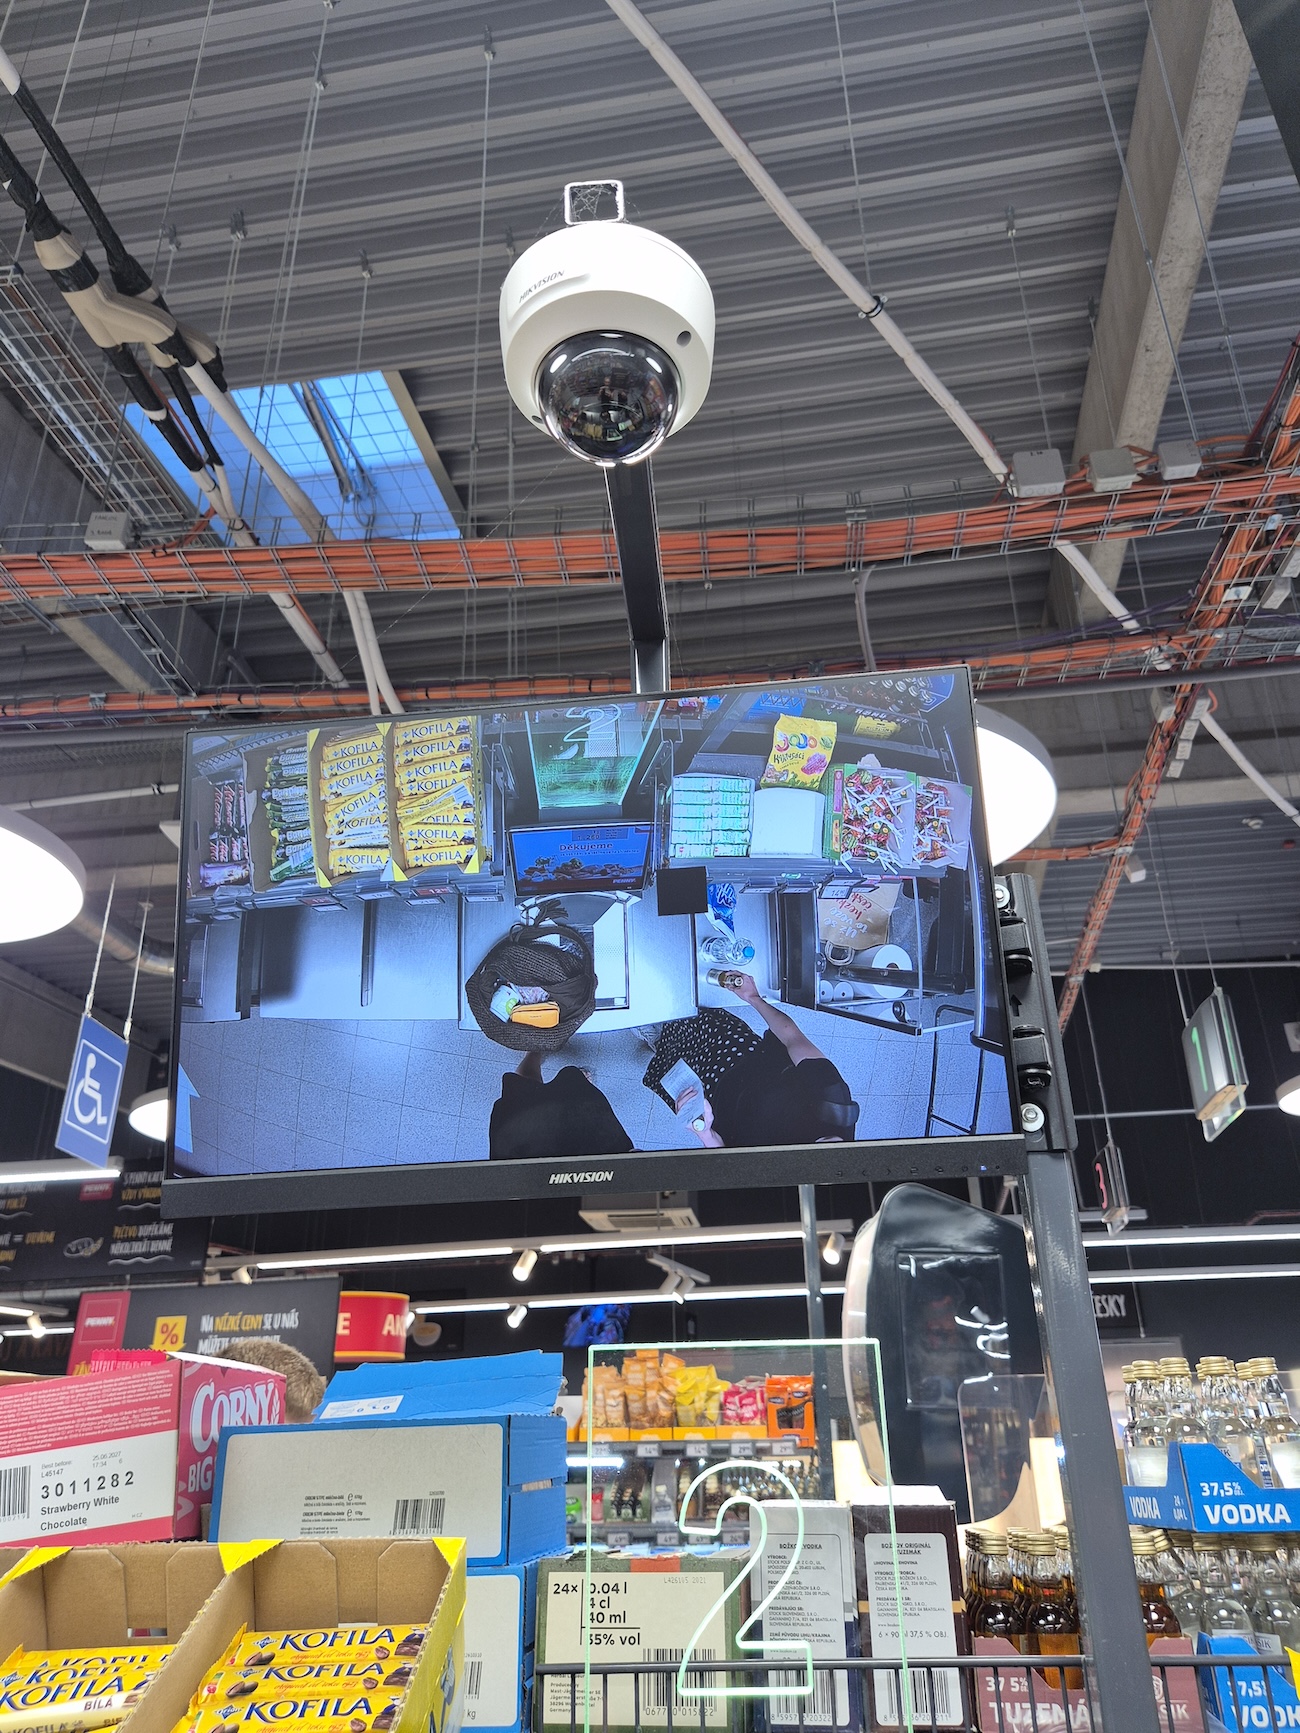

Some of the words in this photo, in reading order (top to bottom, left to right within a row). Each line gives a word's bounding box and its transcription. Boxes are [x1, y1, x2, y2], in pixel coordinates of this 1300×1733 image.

[519, 270, 565, 303] HIKVISION
[411, 721, 454, 738] KOFILA
[340, 741, 378, 757] KOFILA
[413, 740, 456, 757] KOFILA
[336, 756, 374, 772] KOFILA
[415, 760, 458, 777] KOFILA
[335, 771, 373, 790] KOFILA
[340, 791, 377, 817] KOFILA
[417, 829, 459, 840] KOFILA
[559, 842, 614, 853] Děkujeme
[345, 854, 383, 866] KOFILA
[422, 850, 462, 864] KOFILA
[548, 1171, 614, 1184] HIKVISION
[1093, 1294, 1126, 1318] ESKY
[92, 1451, 122, 1461] 25.06.2027
[41, 1469, 64, 1478] L45147
[92, 1461, 107, 1469] 17:34
[41, 1501, 91, 1516] Strawberry
[93, 1495, 120, 1507] White
[1129, 1495, 1161, 1520] VODKA
[1203, 1503, 1291, 1526] VODKA
[40, 1516, 88, 1531] Chocolate
[677, 1458, 814, 1696] 2
[599, 1596, 611, 1609] cl
[609, 1611, 626, 1624] ml
[279, 1627, 396, 1652] KOFILA
[619, 1632, 640, 1646] vol
[263, 1662, 385, 1682] KOFILA
[0, 1676, 124, 1712] KOFILA
[84, 1697, 114, 1712] BÍLÁ
[244, 1697, 373, 1724] KOFILA
[467, 1708, 477, 1720] kg
